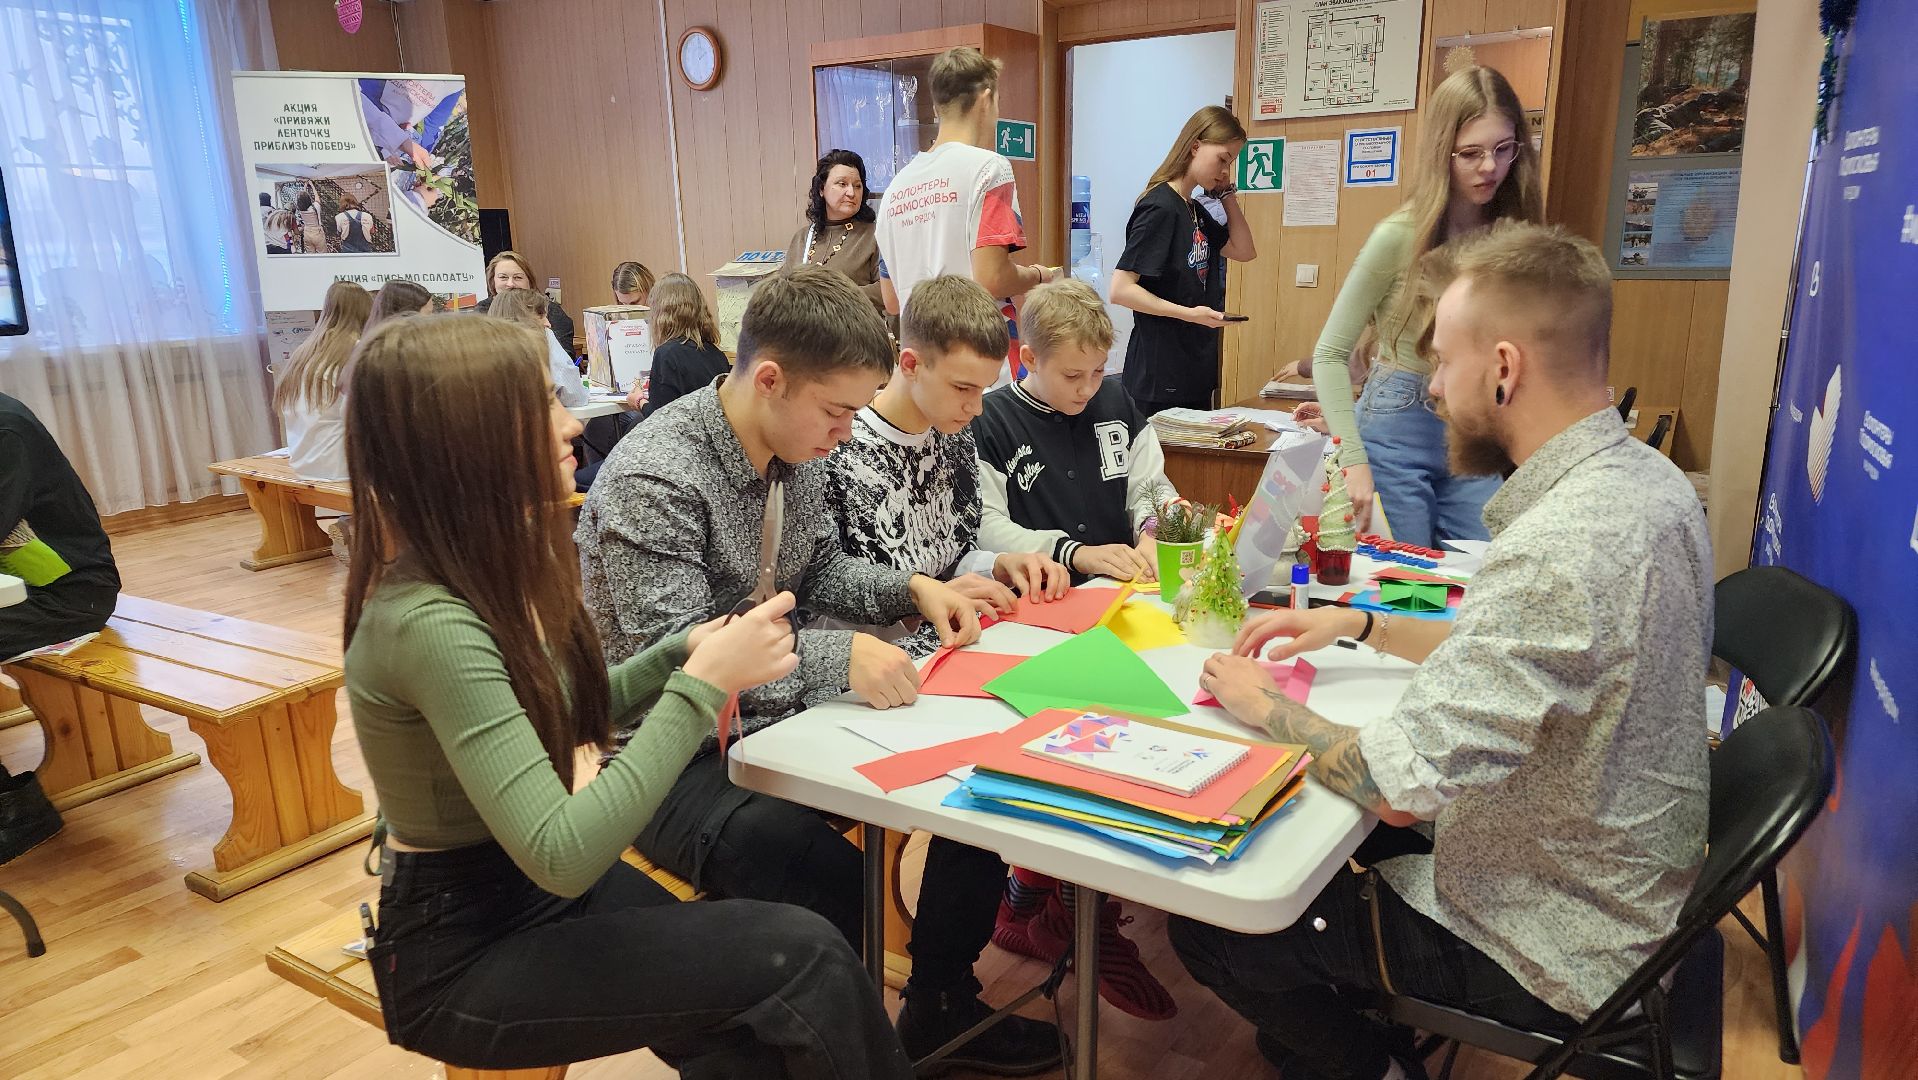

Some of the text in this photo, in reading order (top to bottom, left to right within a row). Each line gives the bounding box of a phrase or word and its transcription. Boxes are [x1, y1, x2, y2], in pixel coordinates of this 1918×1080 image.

[283, 103, 318, 115] АКЦИЯ
[273, 116, 331, 126] «ПРИВЯЖИ
[277, 128, 331, 138] ЛЕНТОЧКУ
[253, 141, 356, 151] ПРИБЛИЗЬ ПОБЕДУ»
[1365, 169, 1376, 178] 01
[890, 178, 950, 204] ВОЛОНТЕРЫ
[737, 252, 786, 261] ПОЧТ
[422, 273, 474, 282] СОЛДАТУ»
[1093, 419, 1130, 482] B
